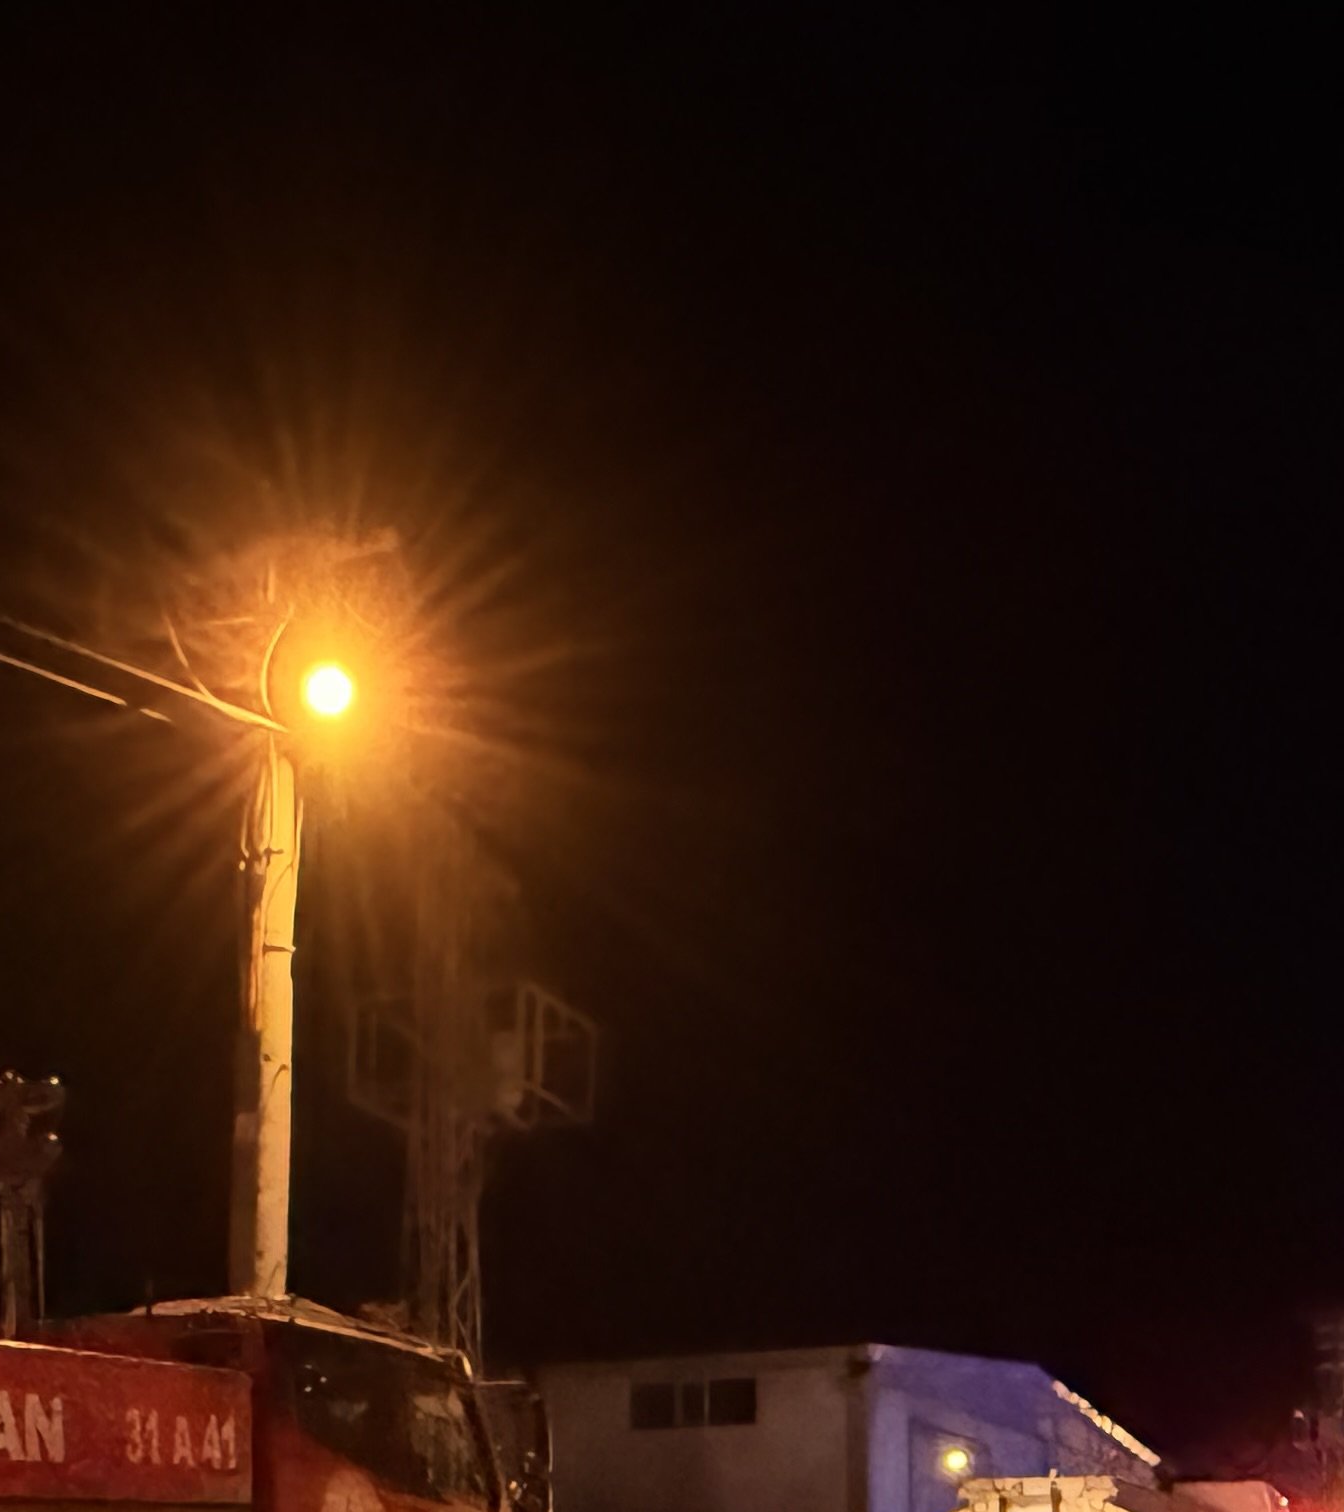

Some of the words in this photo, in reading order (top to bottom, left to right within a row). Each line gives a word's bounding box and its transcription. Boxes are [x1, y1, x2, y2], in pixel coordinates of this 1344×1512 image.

[124, 1407, 161, 1466] 31
[172, 1415, 195, 1468] A
[202, 1409, 237, 1470] 41
